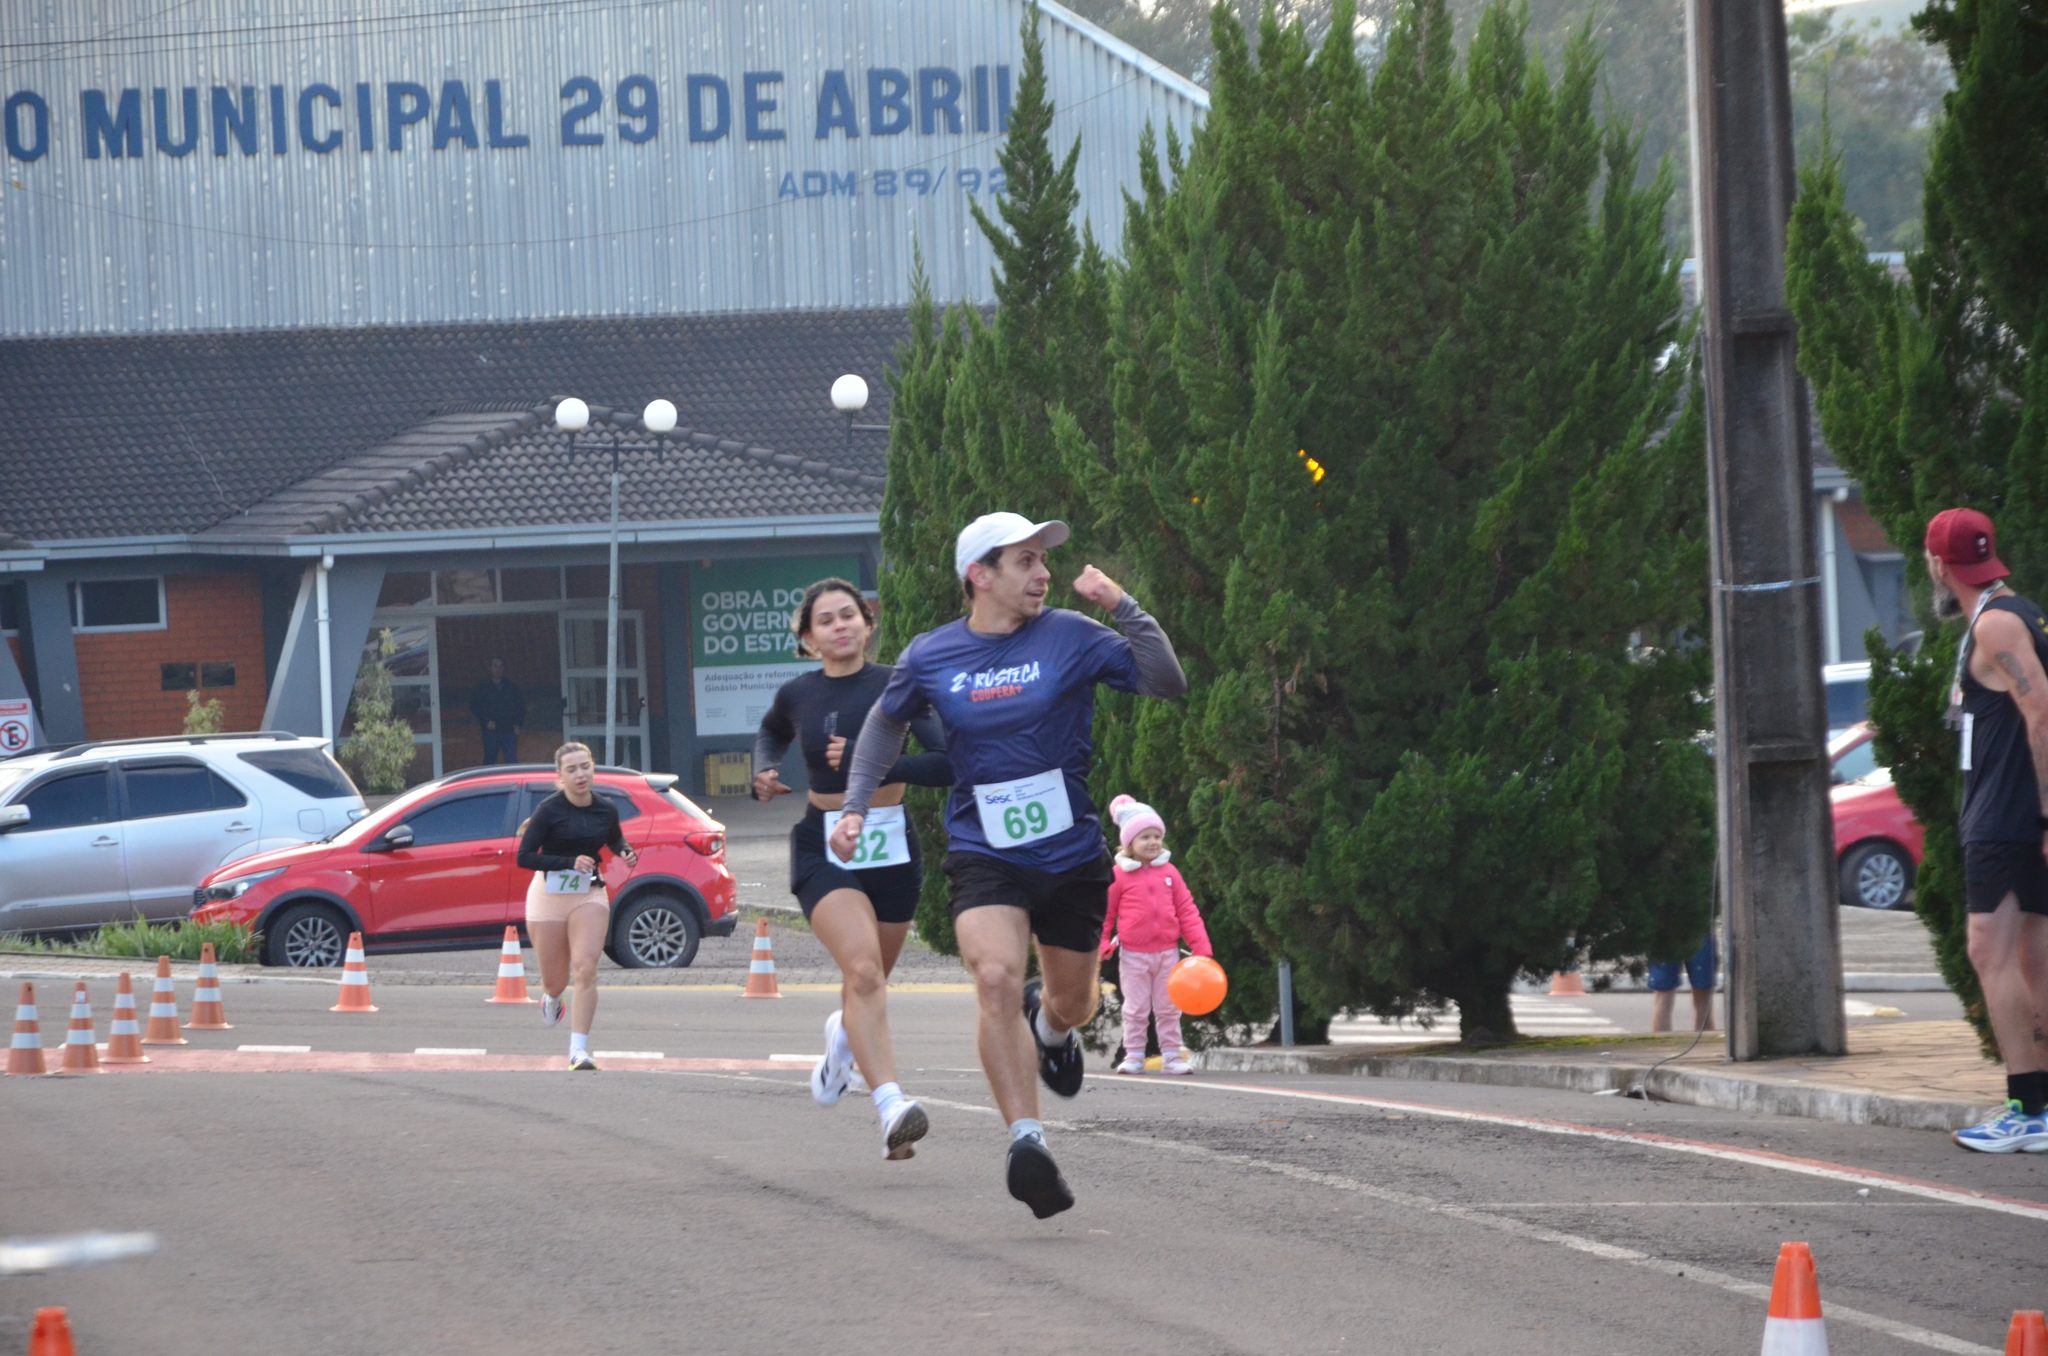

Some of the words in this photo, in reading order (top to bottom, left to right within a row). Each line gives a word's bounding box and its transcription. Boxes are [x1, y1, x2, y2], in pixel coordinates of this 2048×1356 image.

[4, 90, 49, 162] O
[82, 79, 530, 160] MUNICIPAL
[560, 74, 660, 147] 29
[687, 71, 786, 143] DE
[702, 591, 768, 610] OBRA
[773, 588, 805, 607] DO
[703, 611, 793, 632] GOVERN
[704, 635, 739, 654] DO
[704, 671, 755, 682] Adequação
[757, 672, 764, 680] e
[704, 682, 738, 693] Ginásio
[1004, 801, 1048, 839] 69
[559, 874, 580, 891] 74
